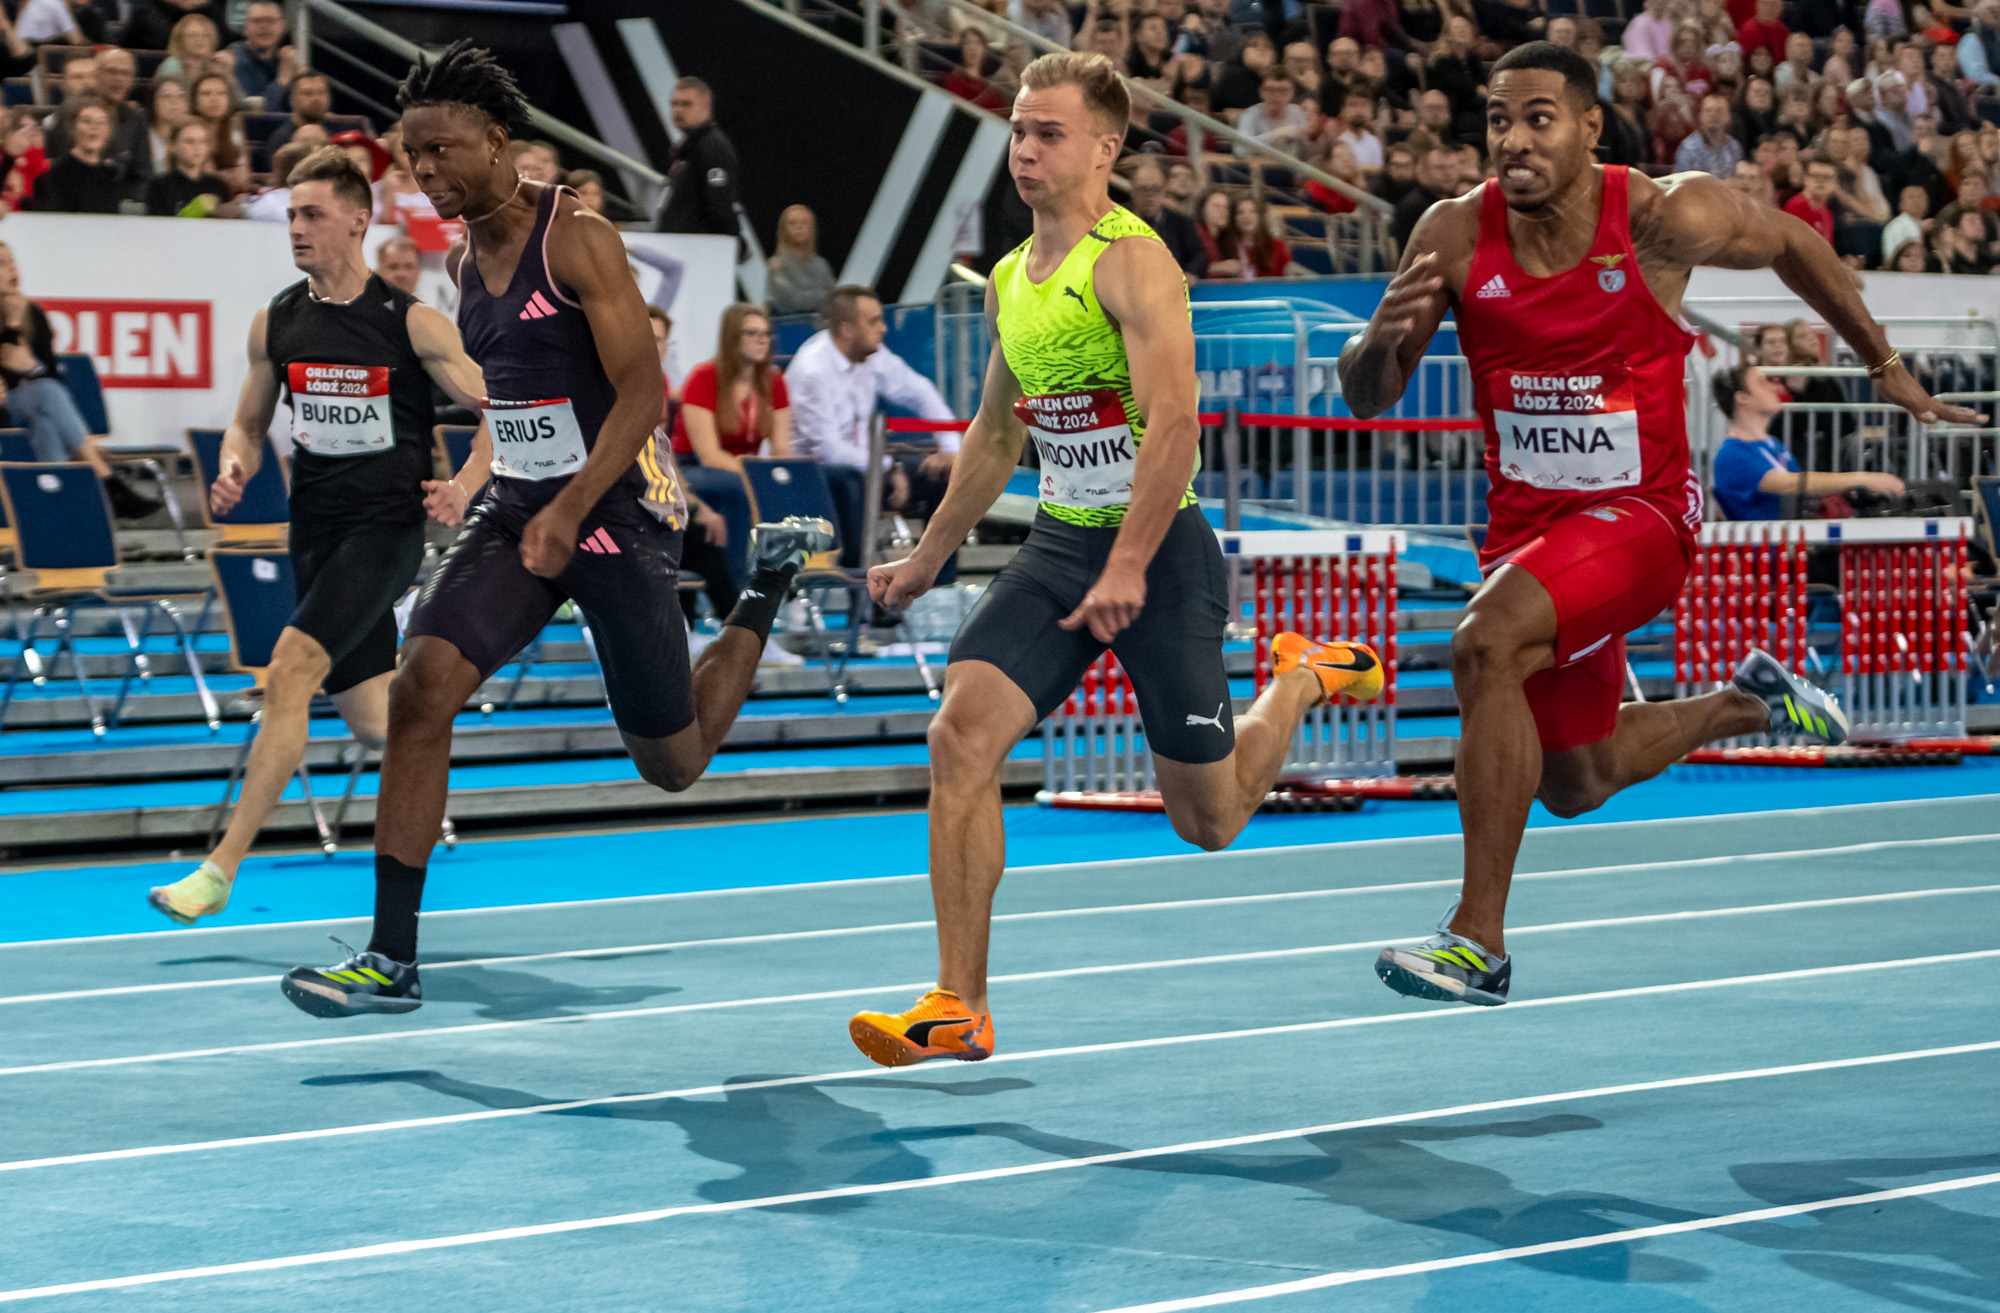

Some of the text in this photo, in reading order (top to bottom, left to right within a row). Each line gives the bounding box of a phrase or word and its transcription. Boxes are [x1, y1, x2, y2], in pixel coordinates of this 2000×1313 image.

[1476, 289, 1511, 298] adidas
[305, 367, 368, 380] ORLEN CUP
[306, 379, 368, 394] ŁÓDŹ 2024
[1510, 375, 1603, 391] ORLEN CUP
[1063, 395, 1093, 410] CUP
[1513, 392, 1605, 410] ŁÓDŹ 2024
[301, 402, 380, 425] BURDA
[1062, 411, 1098, 429] 2024
[495, 415, 556, 443] ERIUS
[1512, 424, 1615, 454] MENA
